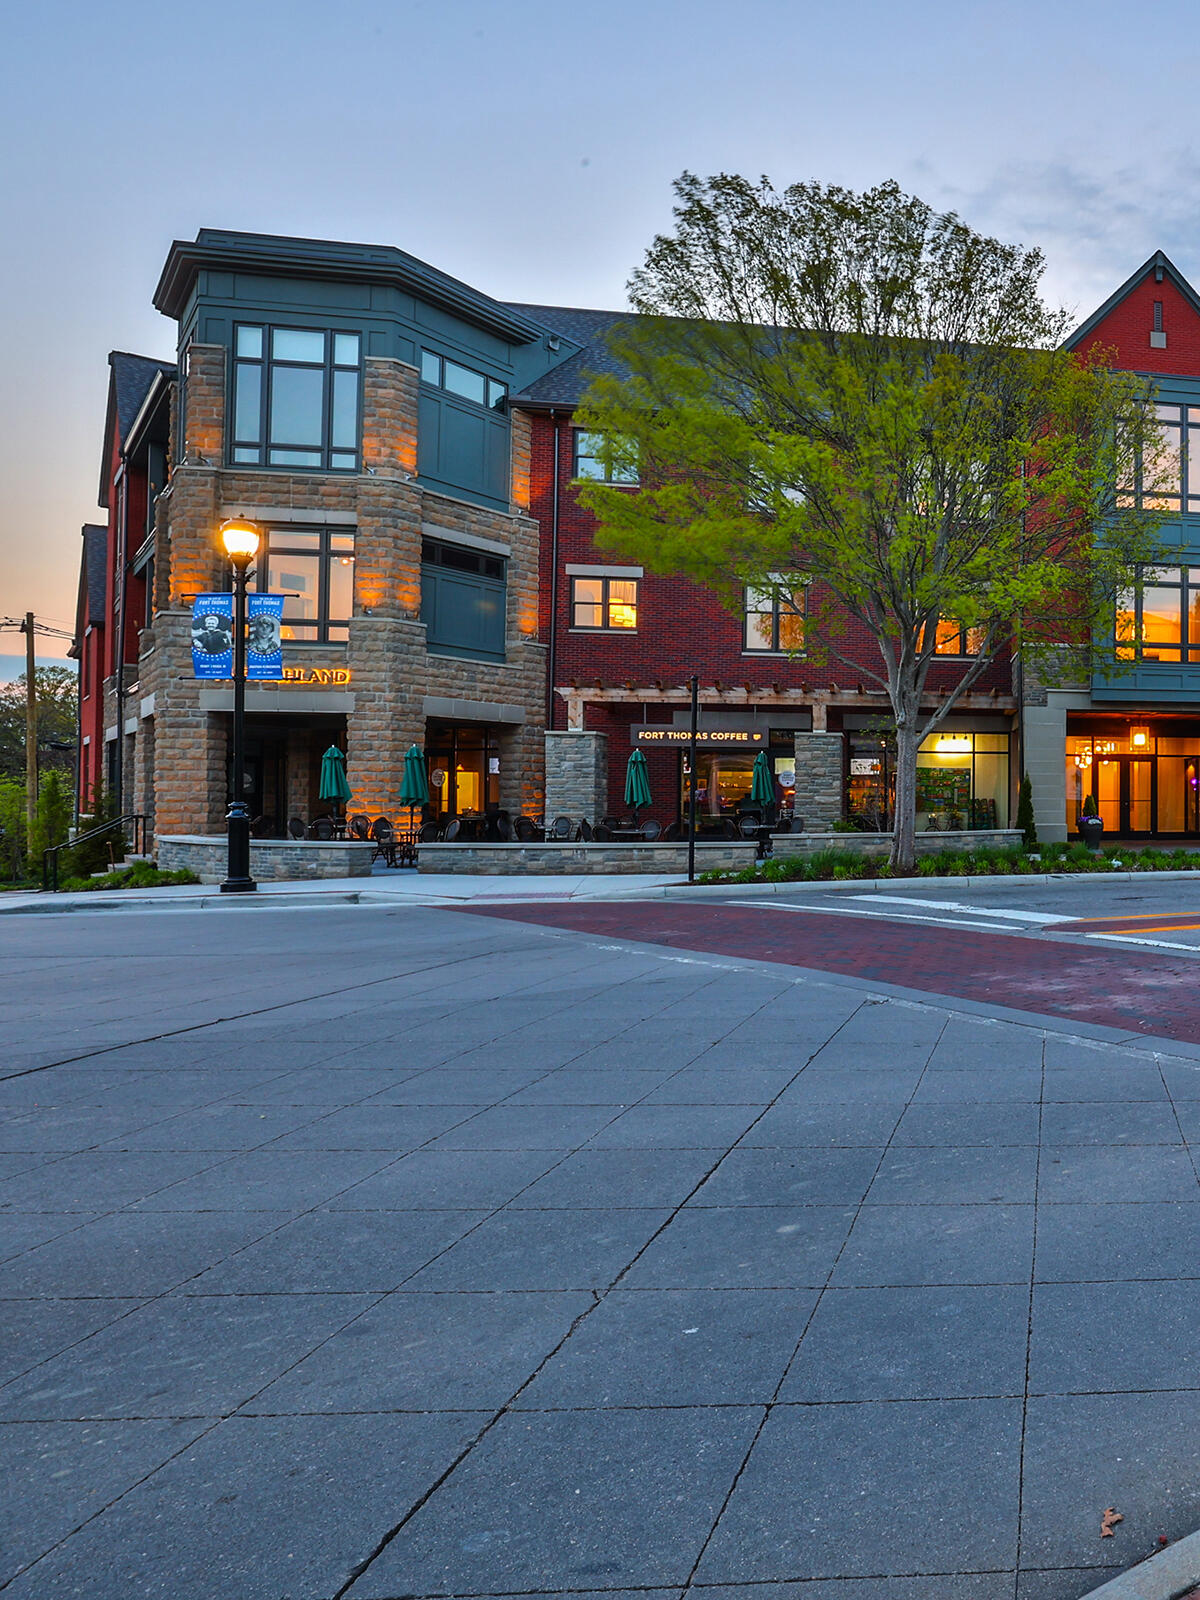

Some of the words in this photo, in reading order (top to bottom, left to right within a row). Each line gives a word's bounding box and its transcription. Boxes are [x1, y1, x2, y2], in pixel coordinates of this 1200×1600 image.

[283, 668, 349, 683] HLAND
[638, 731, 665, 740] FORT
[710, 732, 748, 740] COFFEE
